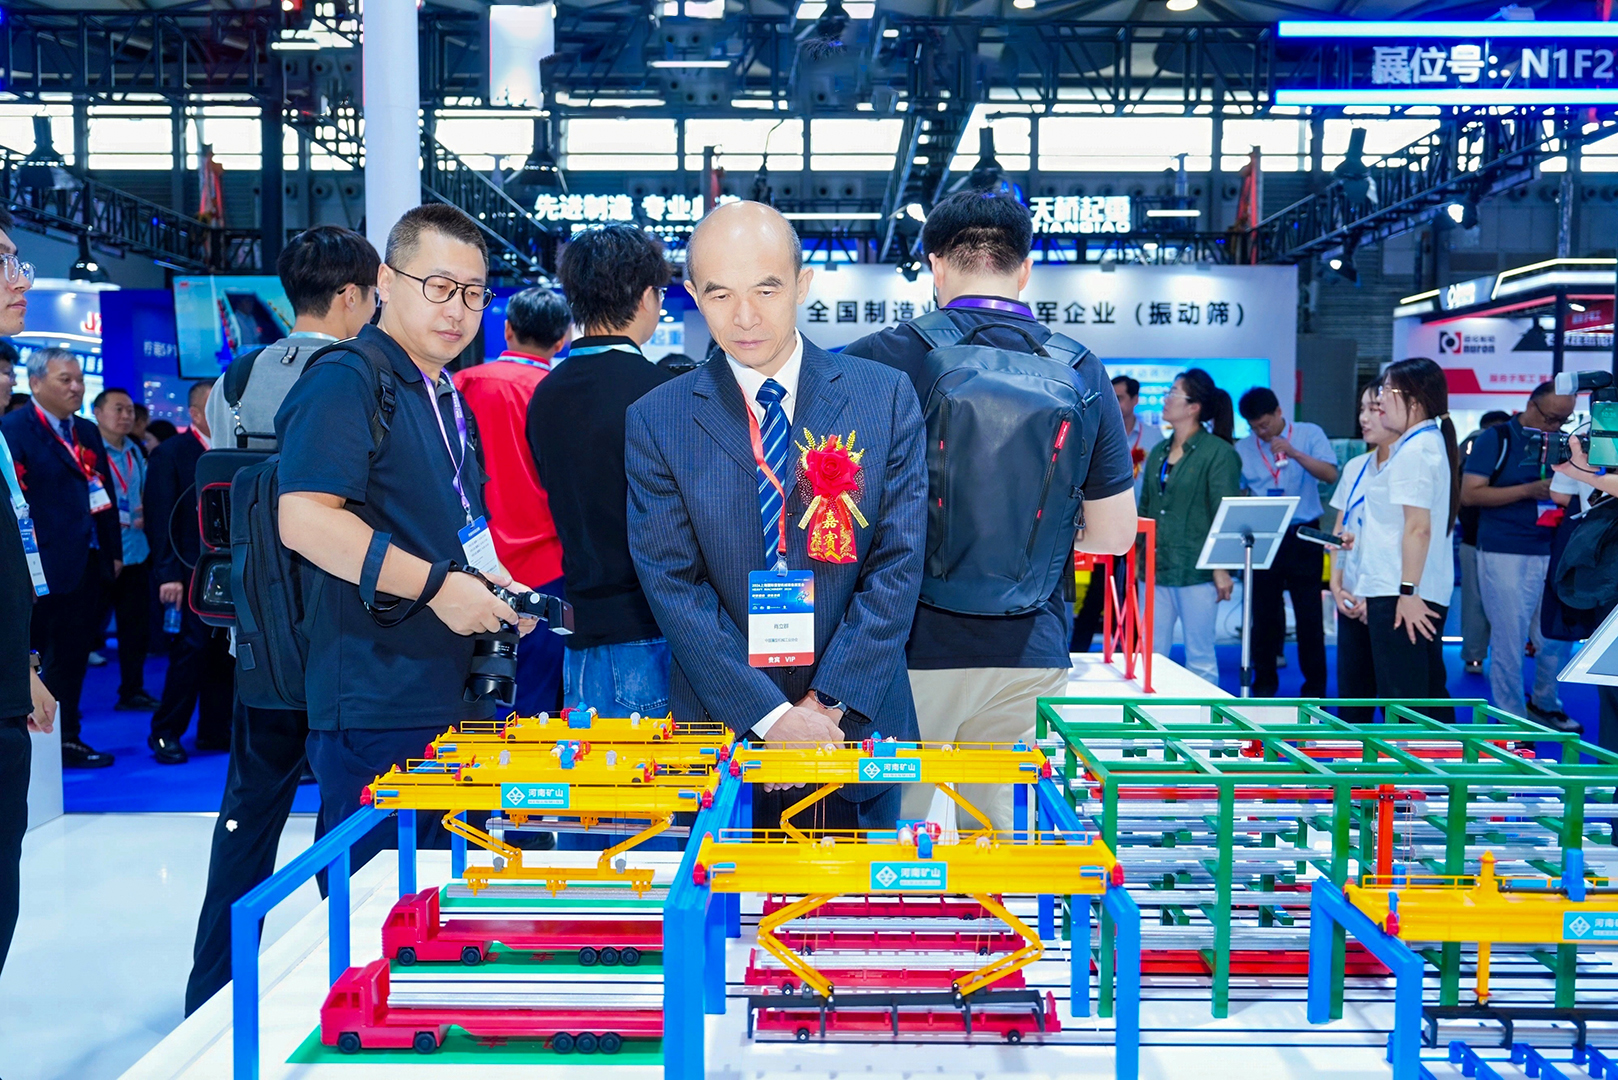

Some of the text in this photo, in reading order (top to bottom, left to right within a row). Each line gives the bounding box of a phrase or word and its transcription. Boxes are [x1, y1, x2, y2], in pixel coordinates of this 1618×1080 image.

[534, 193, 634, 221] 先进制造
[785, 655, 796, 663] VIP
[884, 763, 915, 771] 河南矿山
[529, 788, 563, 797] 河南矿山
[900, 867, 941, 878] 河南矿山
